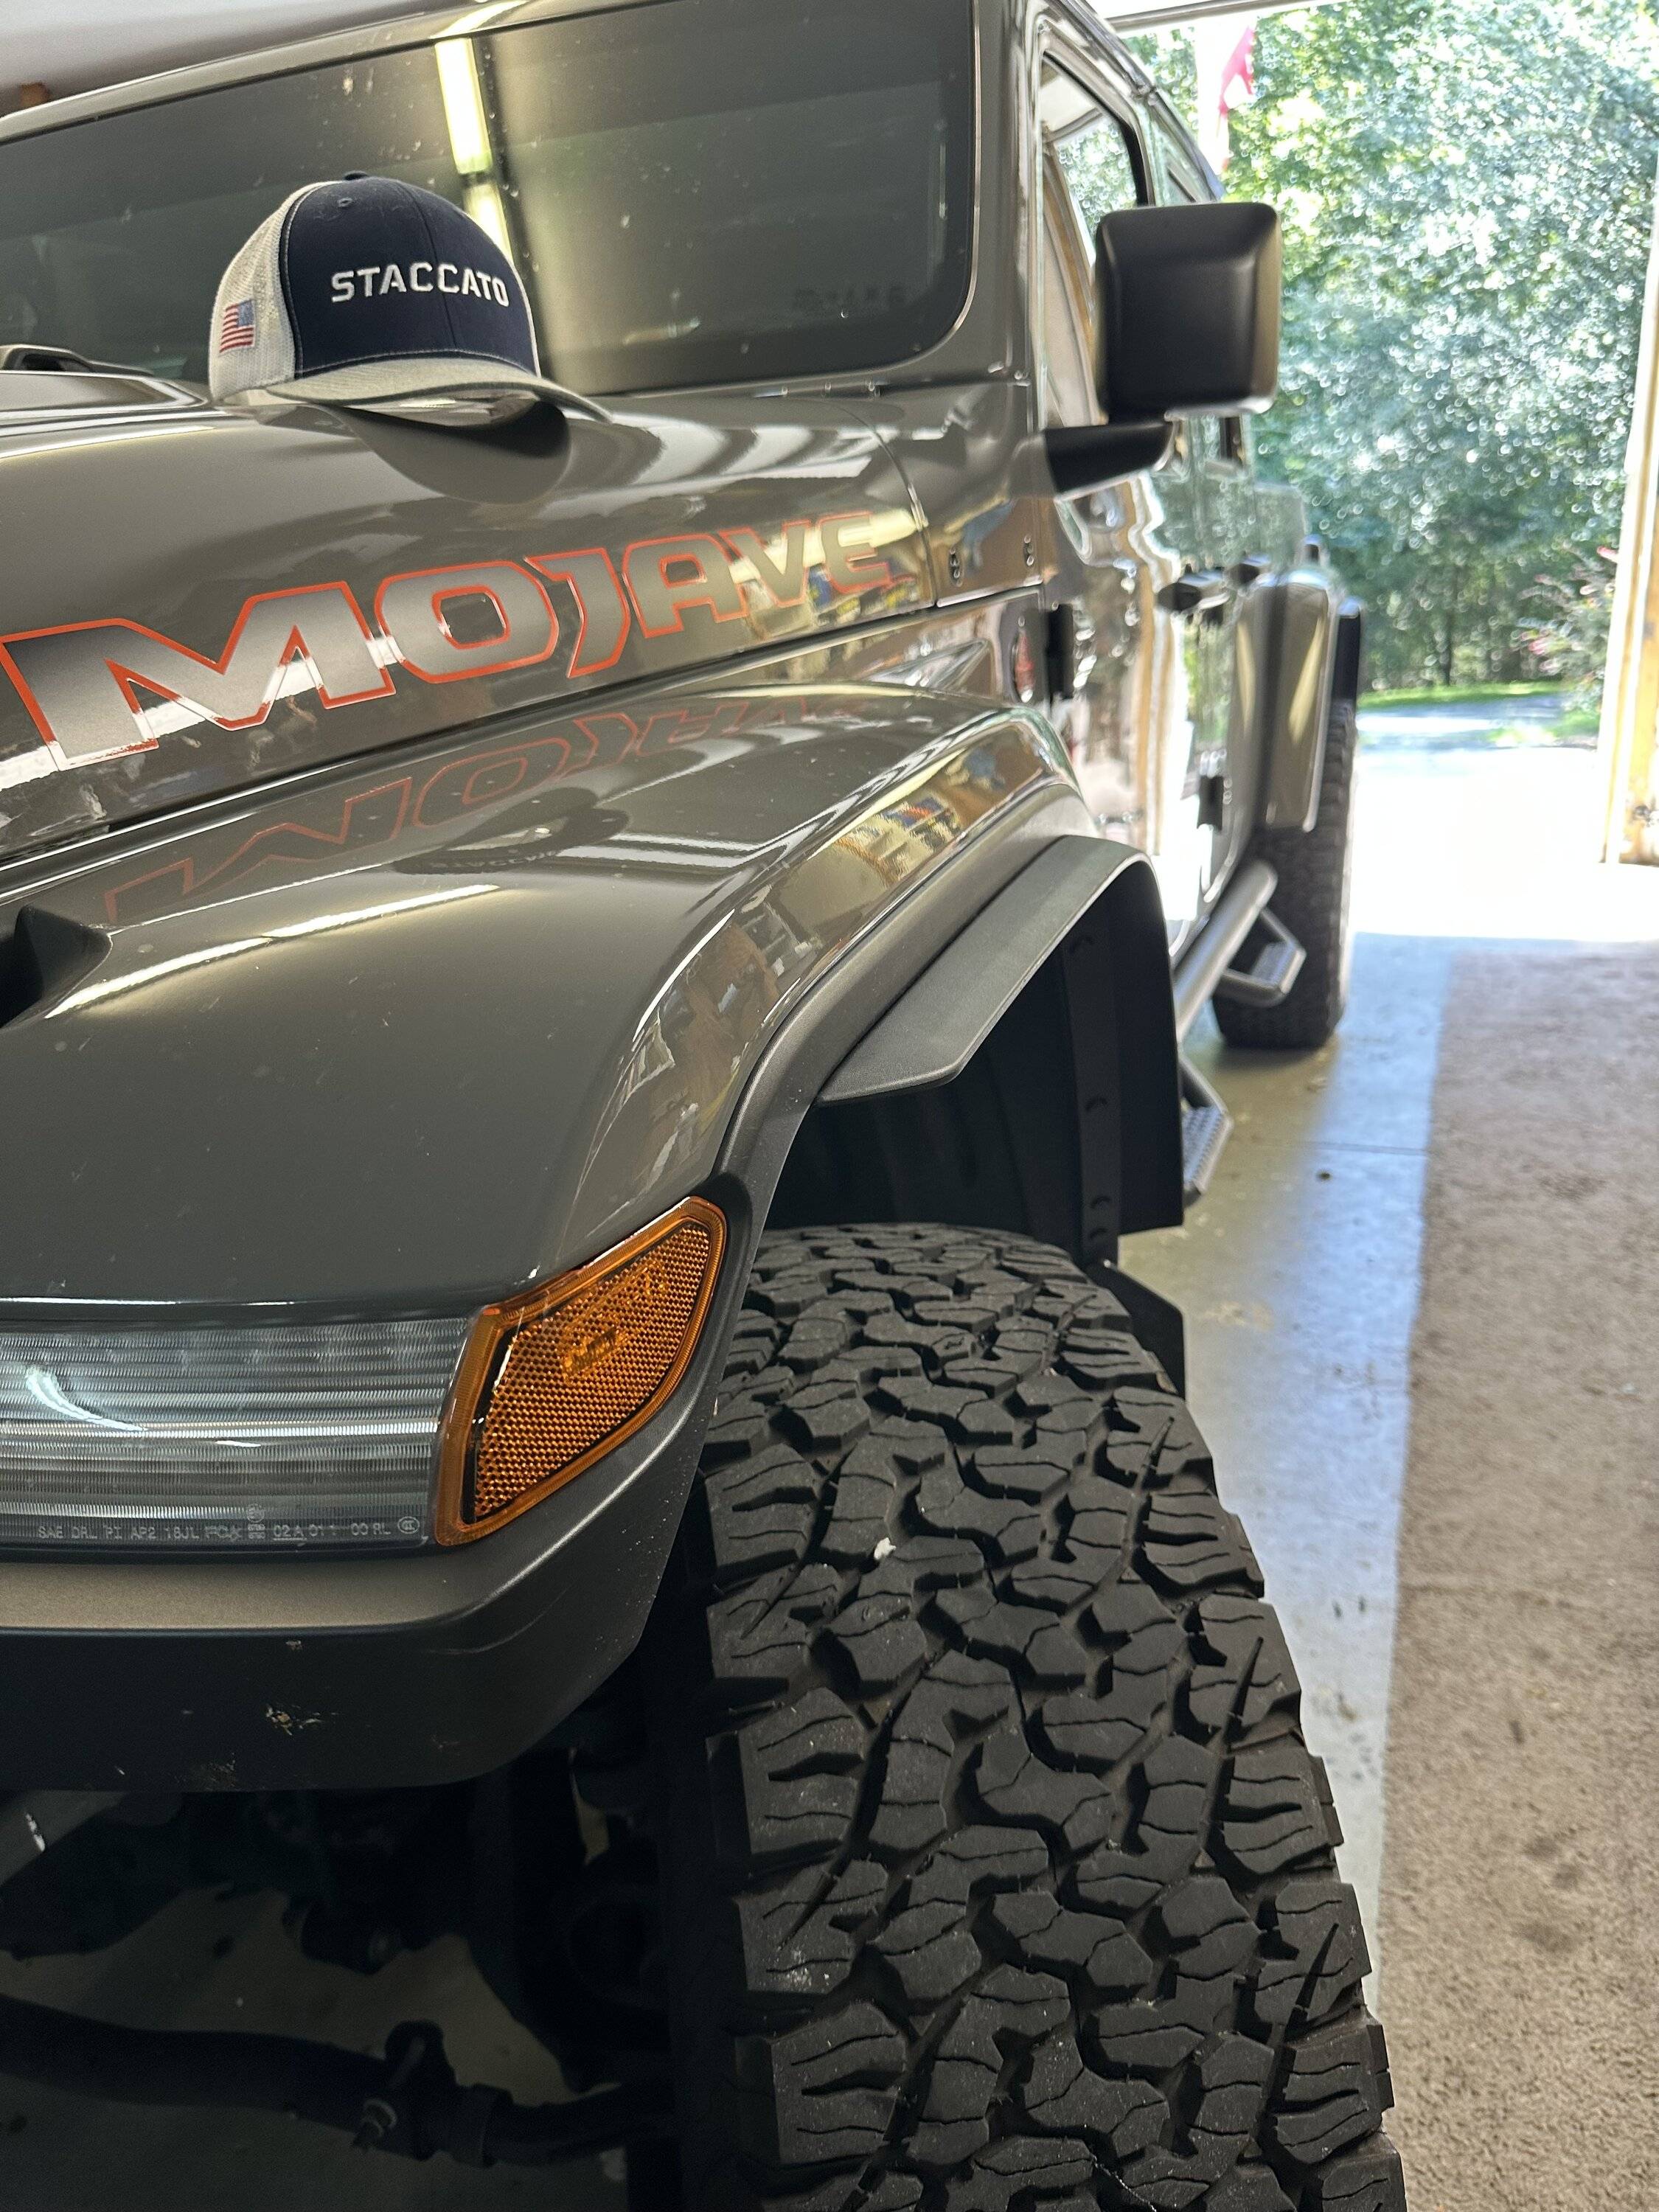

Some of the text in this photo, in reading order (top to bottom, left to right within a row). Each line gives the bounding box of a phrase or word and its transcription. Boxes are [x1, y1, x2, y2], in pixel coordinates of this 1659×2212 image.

[330, 261, 510, 308] STACCATO
[0, 510, 892, 770] MOJAVE
[38, 1526, 64, 1539] SAE
